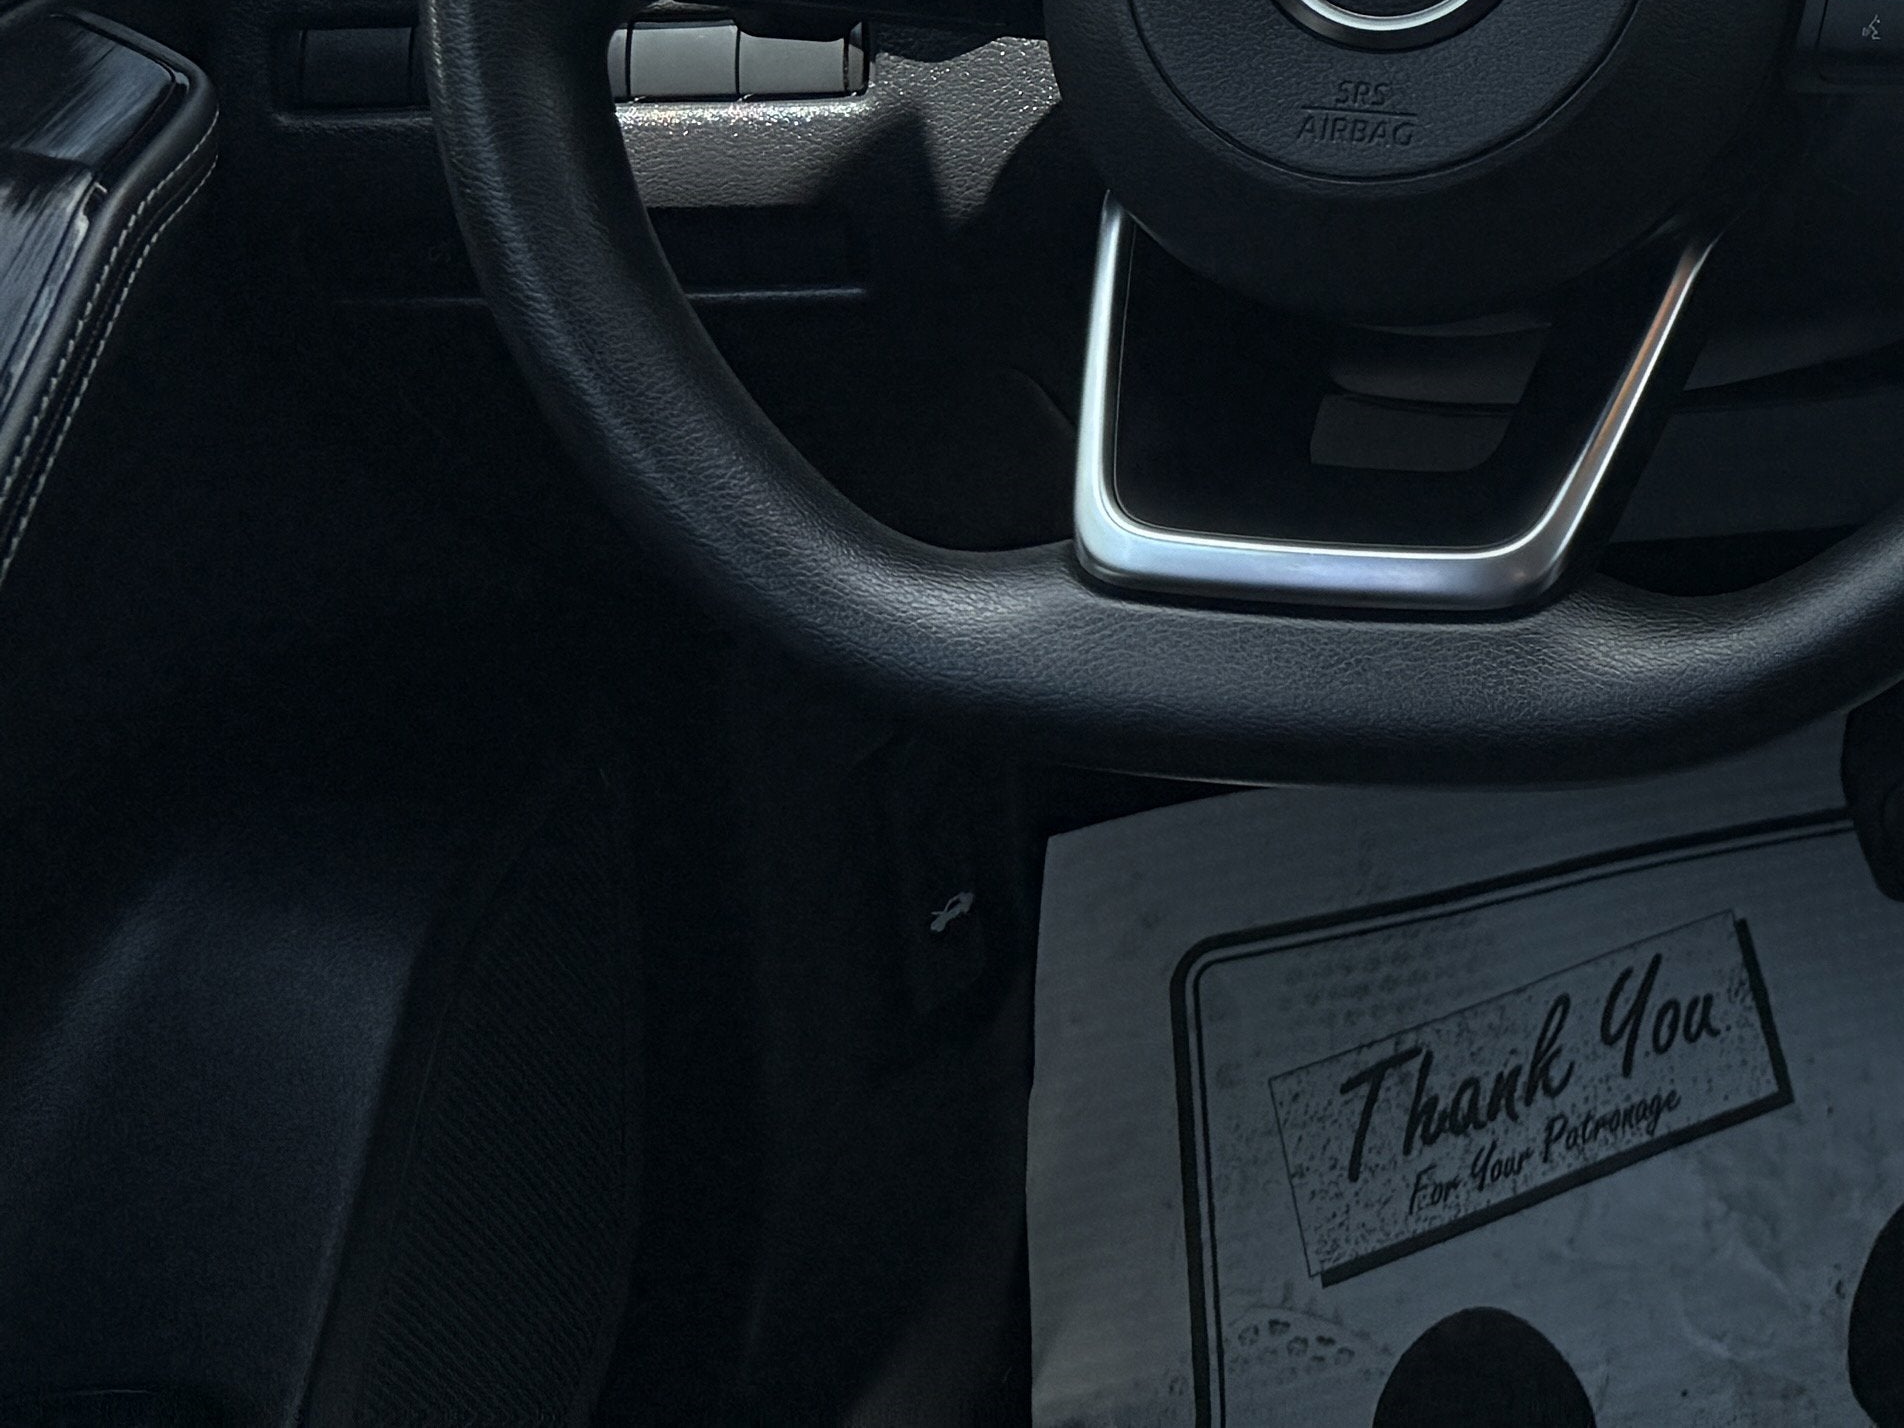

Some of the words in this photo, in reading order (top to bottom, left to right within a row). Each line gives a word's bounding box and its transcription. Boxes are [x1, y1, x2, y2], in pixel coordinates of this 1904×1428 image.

[1297, 116, 1416, 148] AIRBAG
[1334, 80, 1388, 106] SRS
[1340, 991, 1578, 1183] Thank
[1601, 952, 1723, 1079] You
[1407, 1164, 1461, 1217] For
[1471, 1143, 1532, 1192] Your
[1542, 1088, 1682, 1162] Patronage
